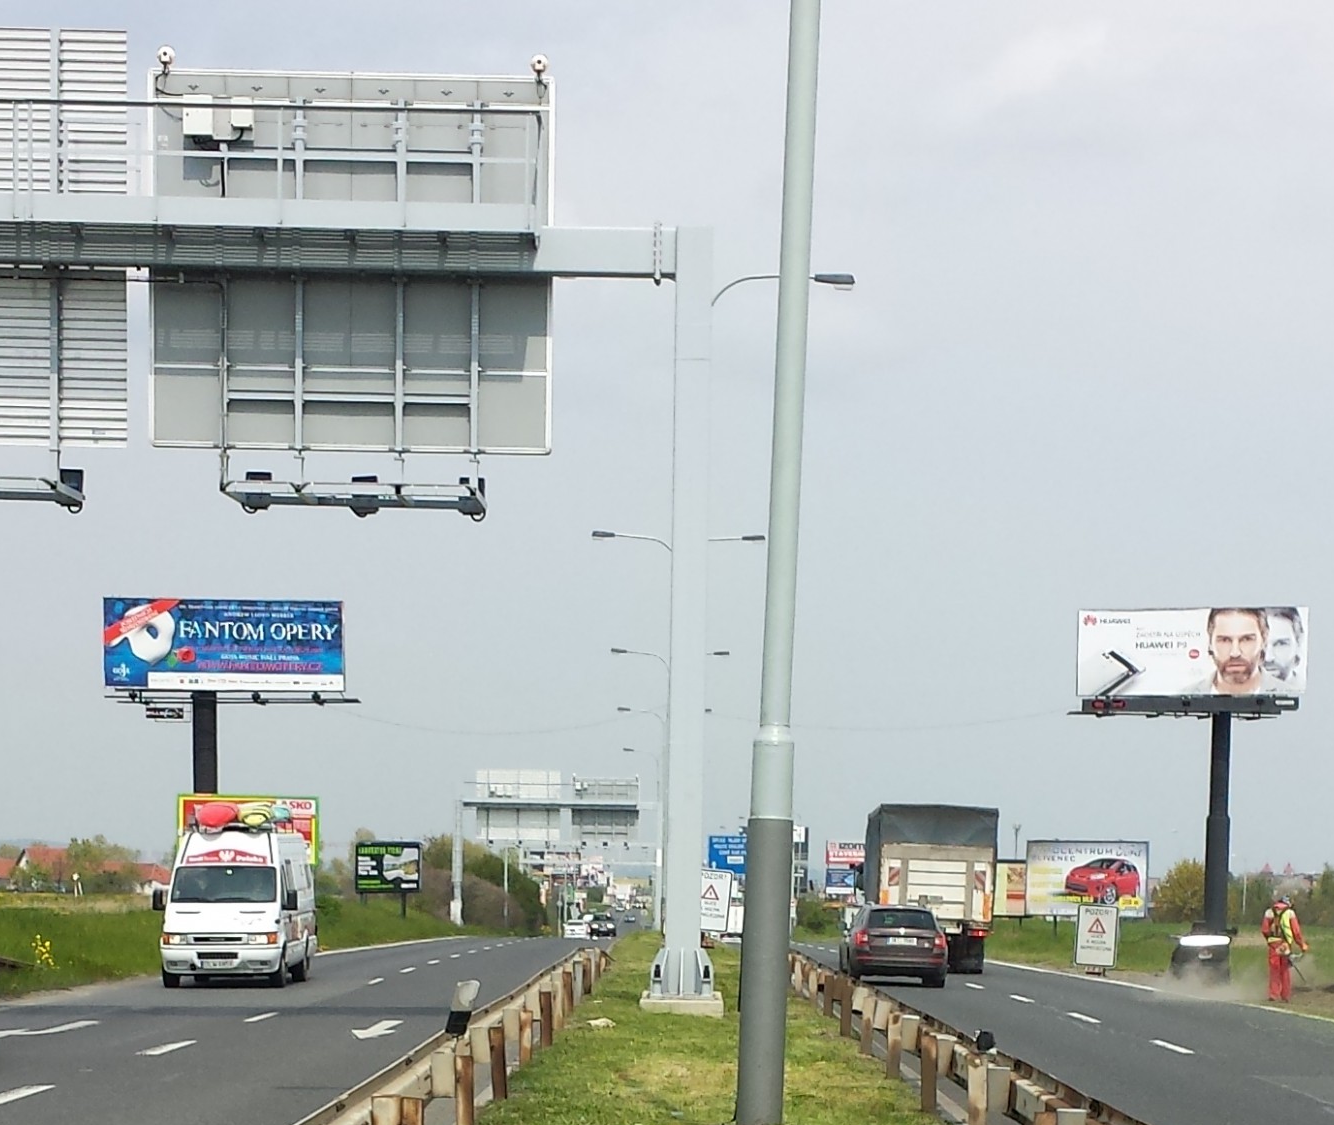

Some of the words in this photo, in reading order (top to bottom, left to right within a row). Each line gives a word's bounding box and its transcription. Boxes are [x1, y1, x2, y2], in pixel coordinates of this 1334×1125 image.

[179, 620, 265, 641] FANTOM
[270, 622, 339, 641] OPERY
[1135, 641, 1174, 649] HUAWEI
